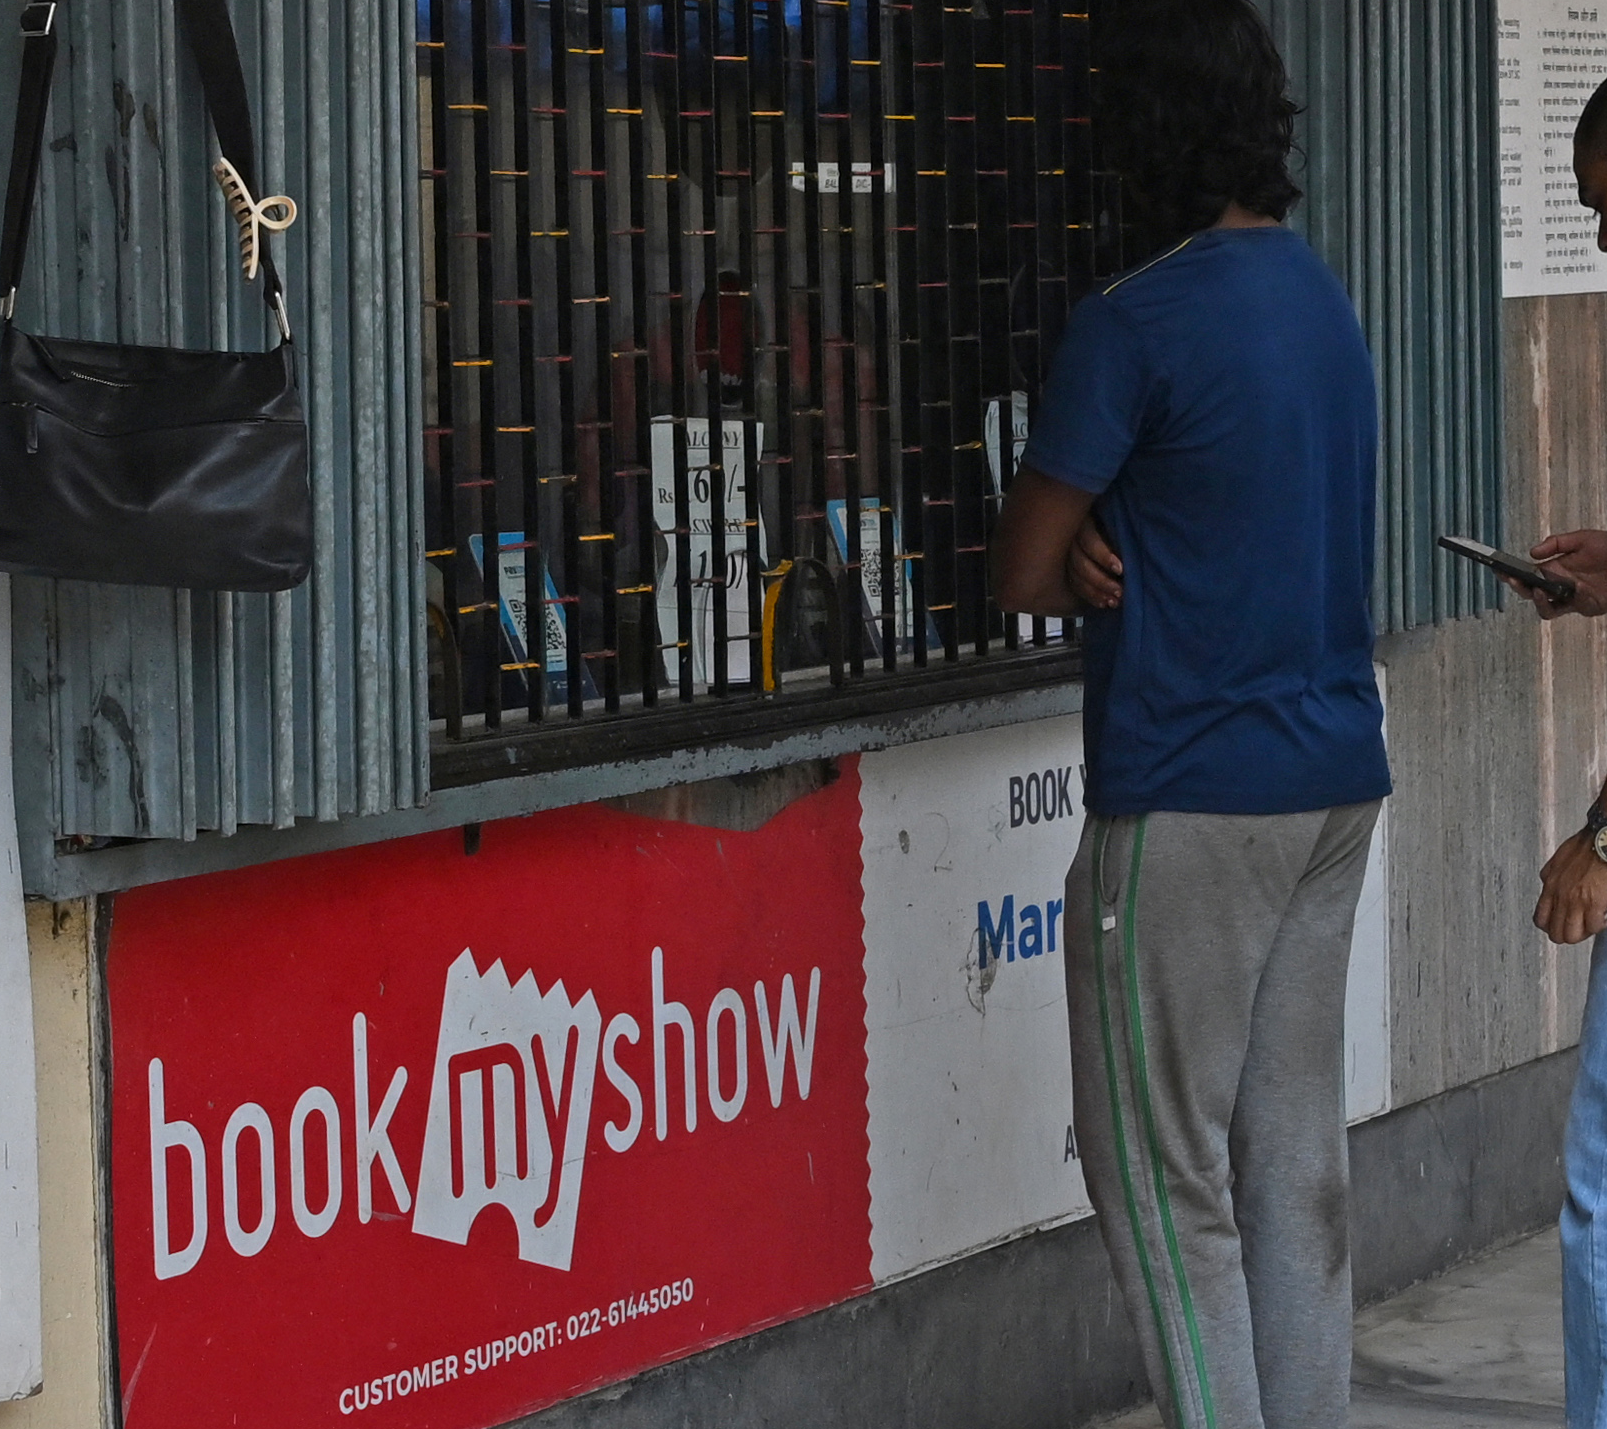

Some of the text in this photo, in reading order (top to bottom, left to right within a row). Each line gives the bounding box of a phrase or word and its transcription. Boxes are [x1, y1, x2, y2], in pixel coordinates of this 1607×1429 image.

[1009, 765, 1073, 829] BOOK
[339, 1277, 694, 1415] CUSTOMER SUPPORT: 022-61445050
